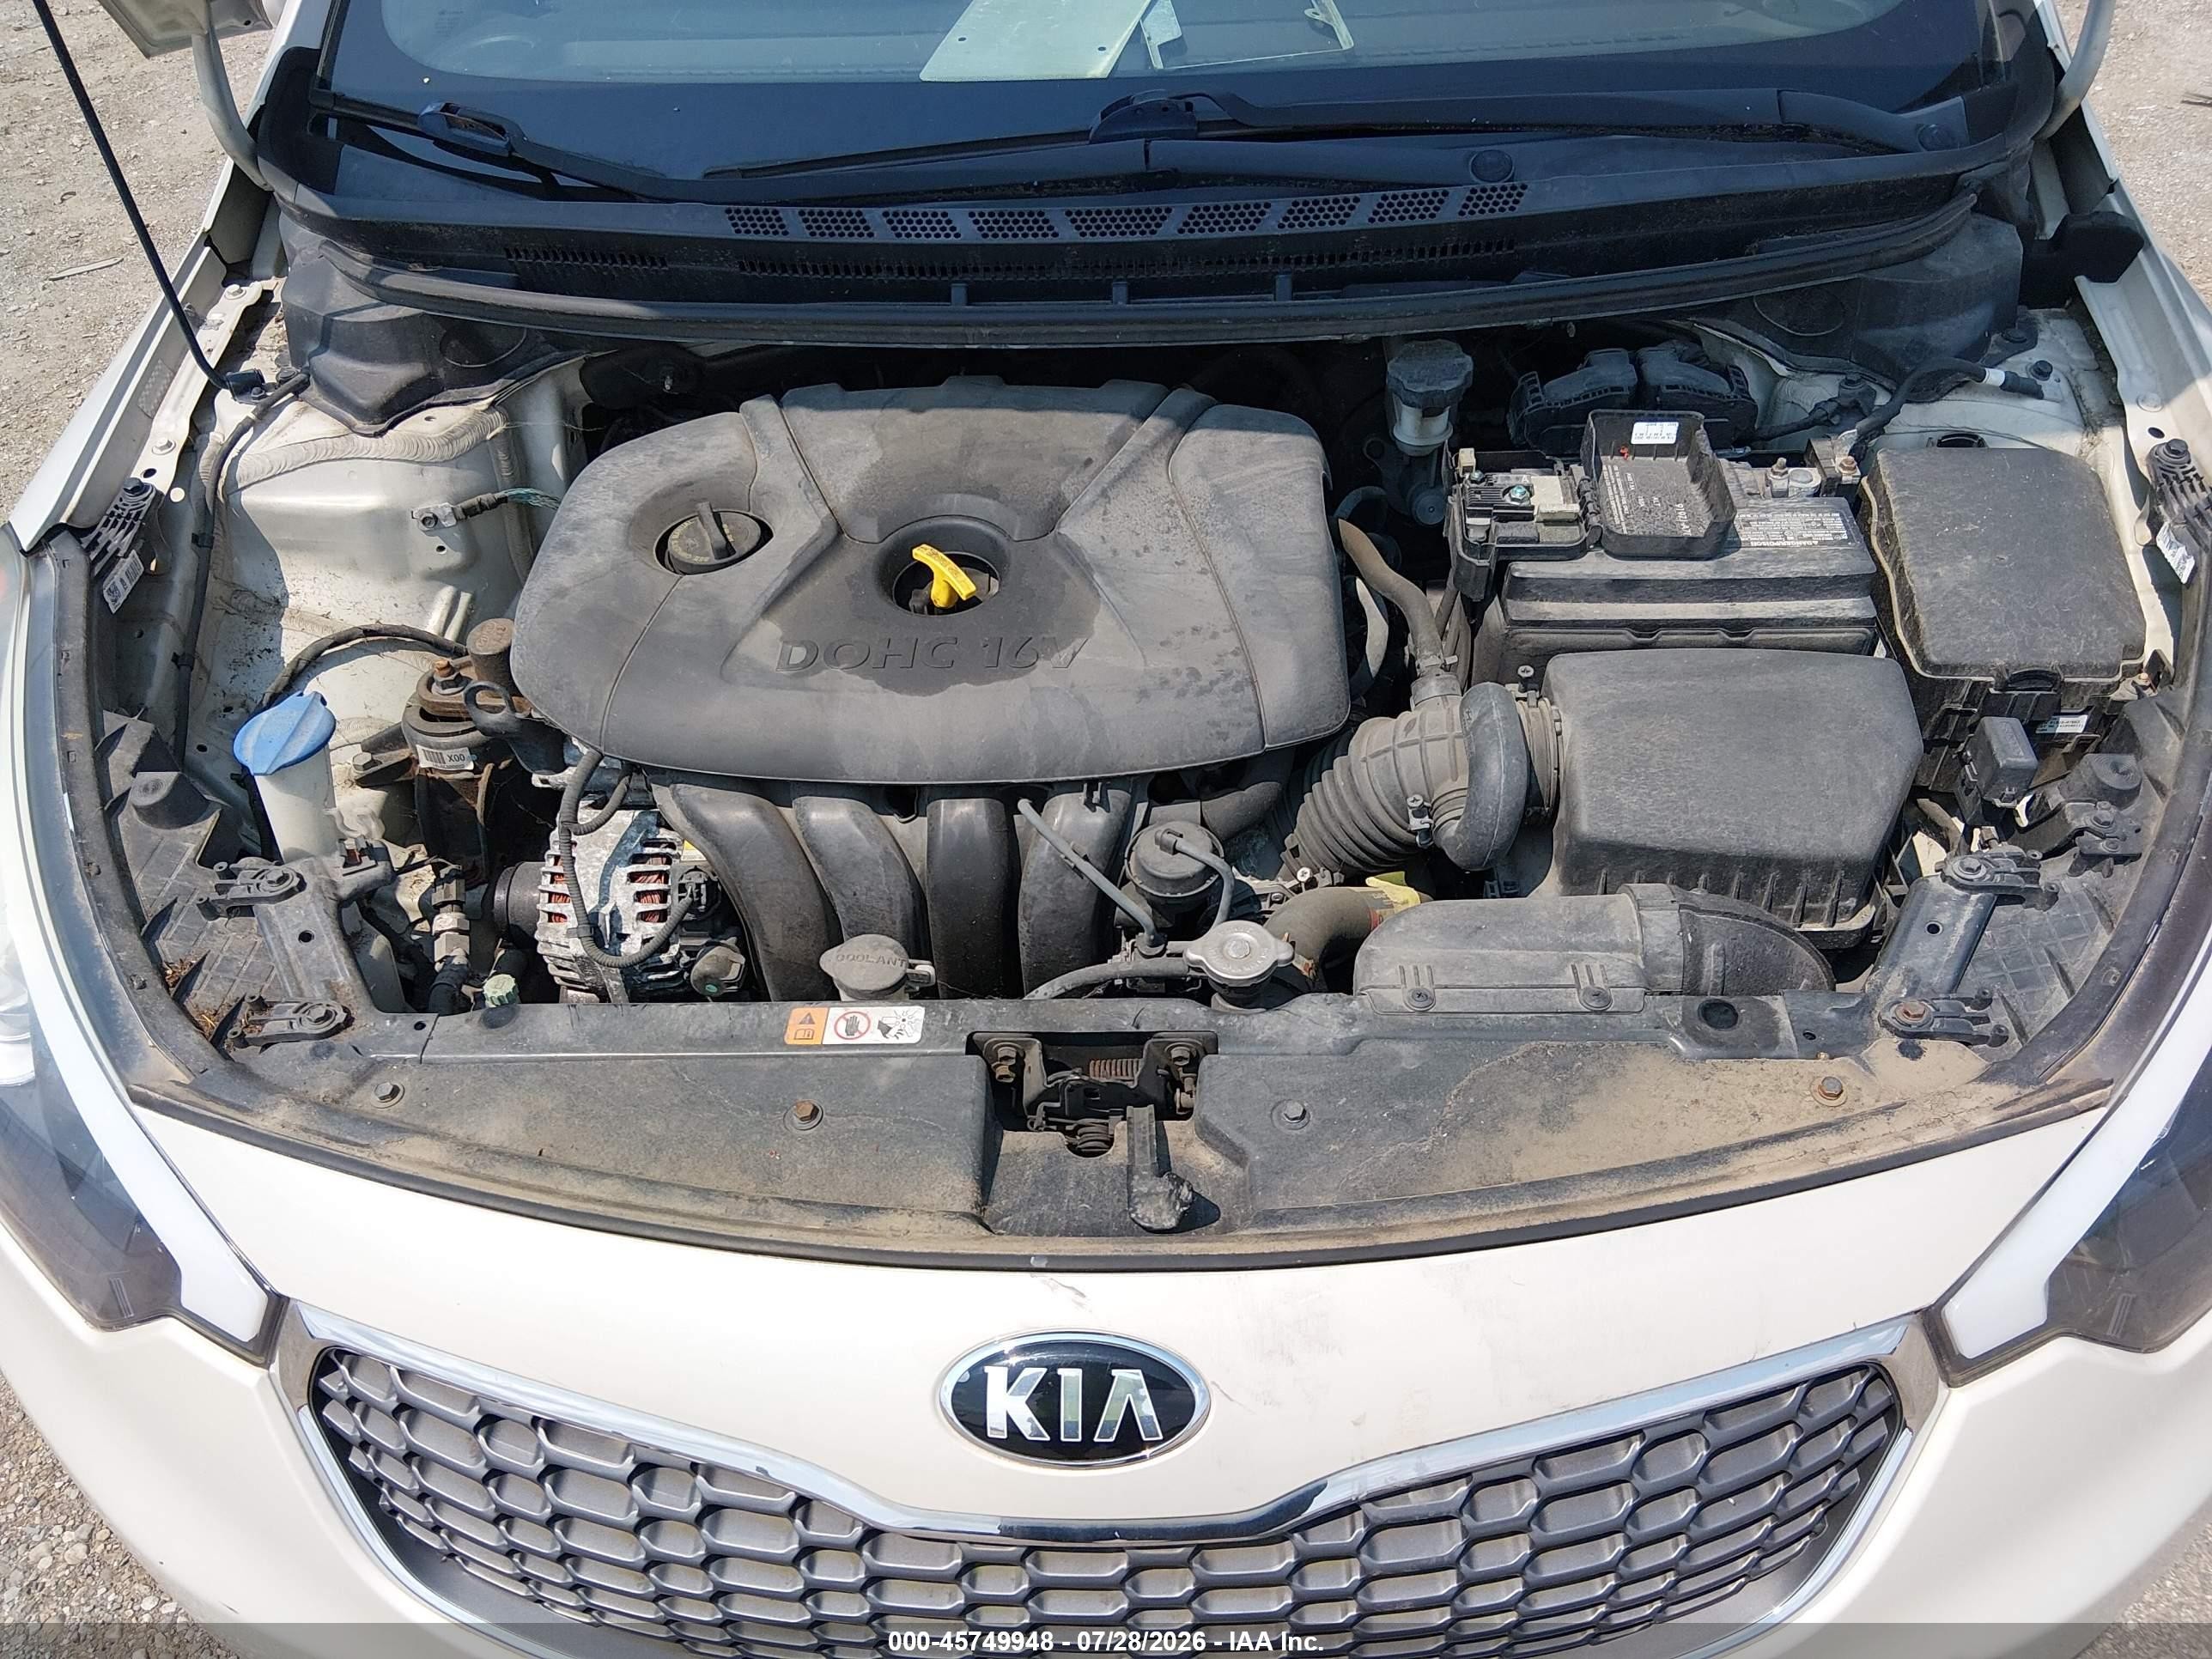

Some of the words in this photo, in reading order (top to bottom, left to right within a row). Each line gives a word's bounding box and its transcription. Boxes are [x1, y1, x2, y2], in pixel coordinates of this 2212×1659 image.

[775, 637, 957, 672] DOHC
[981, 637, 1089, 669] 16V
[836, 953, 906, 968] COOLANT
[984, 1365, 1164, 1442] KIA
